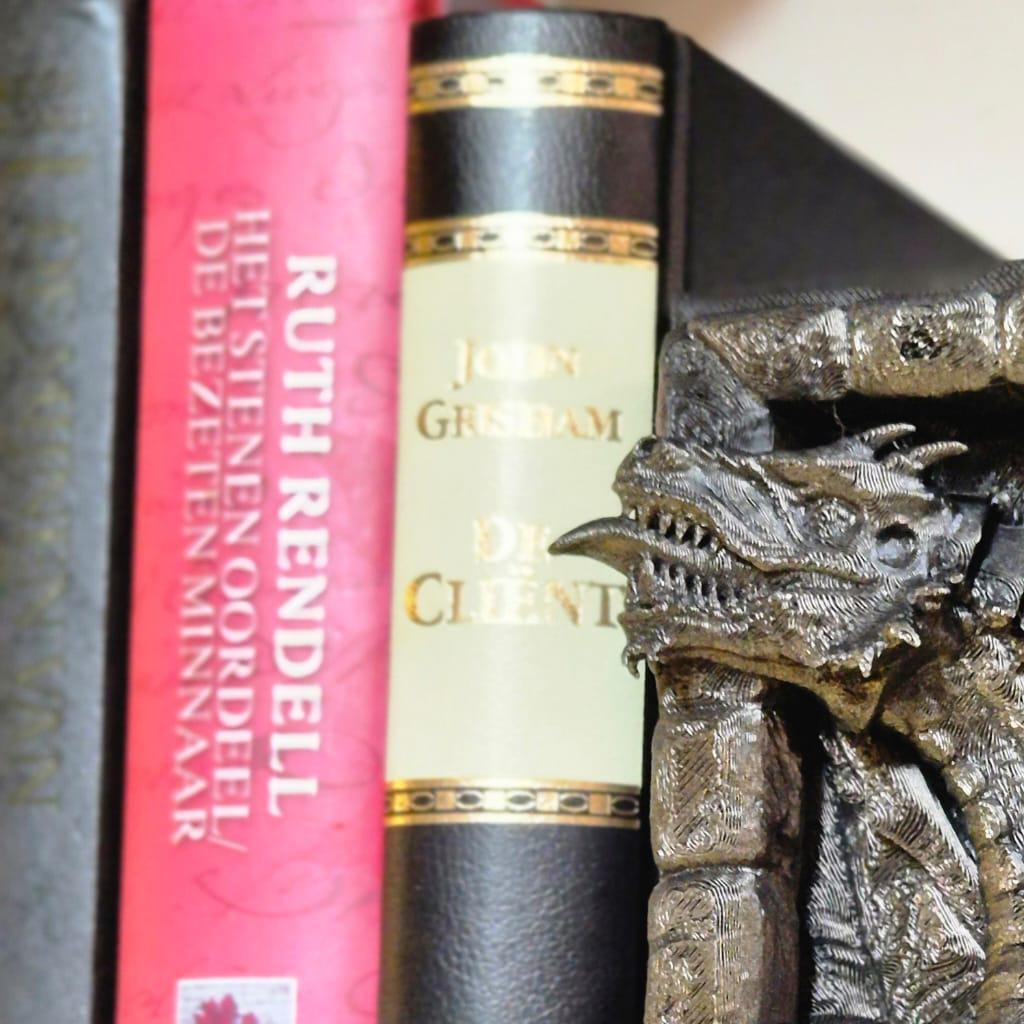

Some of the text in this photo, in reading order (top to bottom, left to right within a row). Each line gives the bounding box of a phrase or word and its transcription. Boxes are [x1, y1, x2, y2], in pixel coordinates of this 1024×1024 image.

[171, 220, 229, 846] DE BEZETEN MINNAAR
[208, 208, 271, 852] HET STENEN OORDEEL/
[267, 254, 338, 817] RUTH RENDELL
